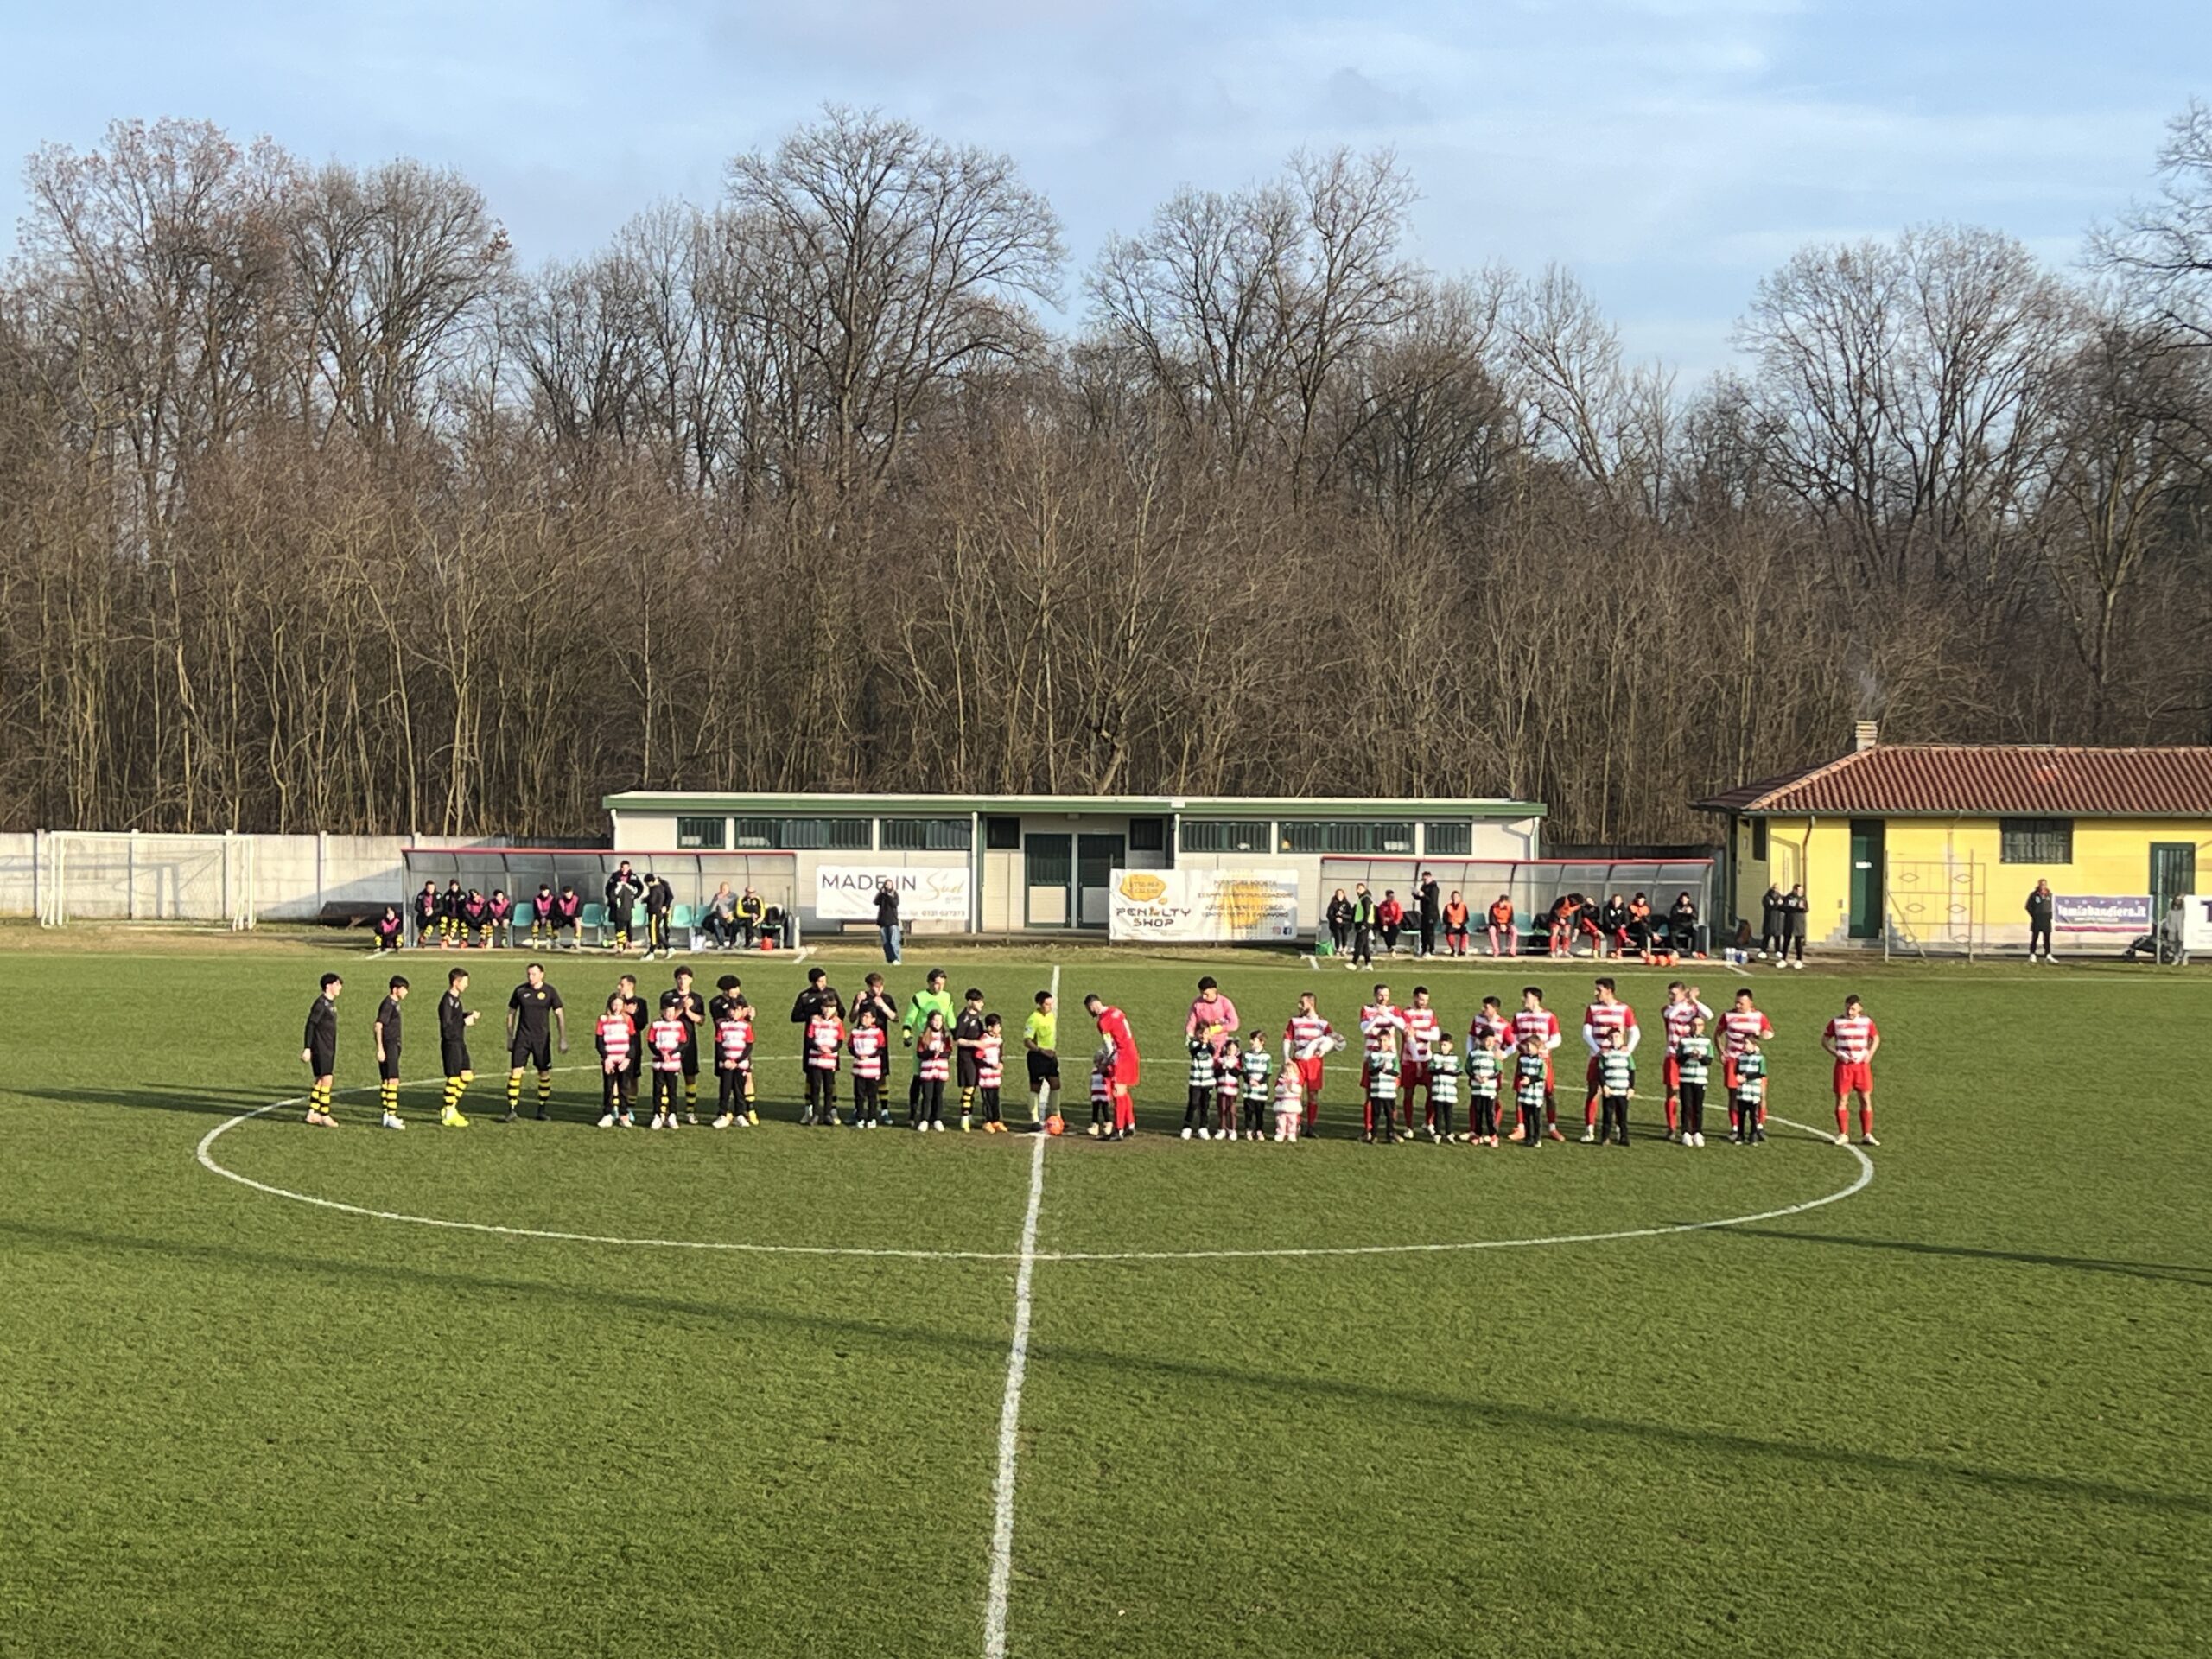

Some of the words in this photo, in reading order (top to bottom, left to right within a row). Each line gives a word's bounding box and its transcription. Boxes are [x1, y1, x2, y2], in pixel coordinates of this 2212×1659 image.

[822, 874, 887, 890] MADE
[895, 875, 916, 891] IN
[922, 870, 965, 901] Sud
[2057, 905, 2146, 918] lamiabandiera.it
[1133, 917, 1174, 927] SHOP
